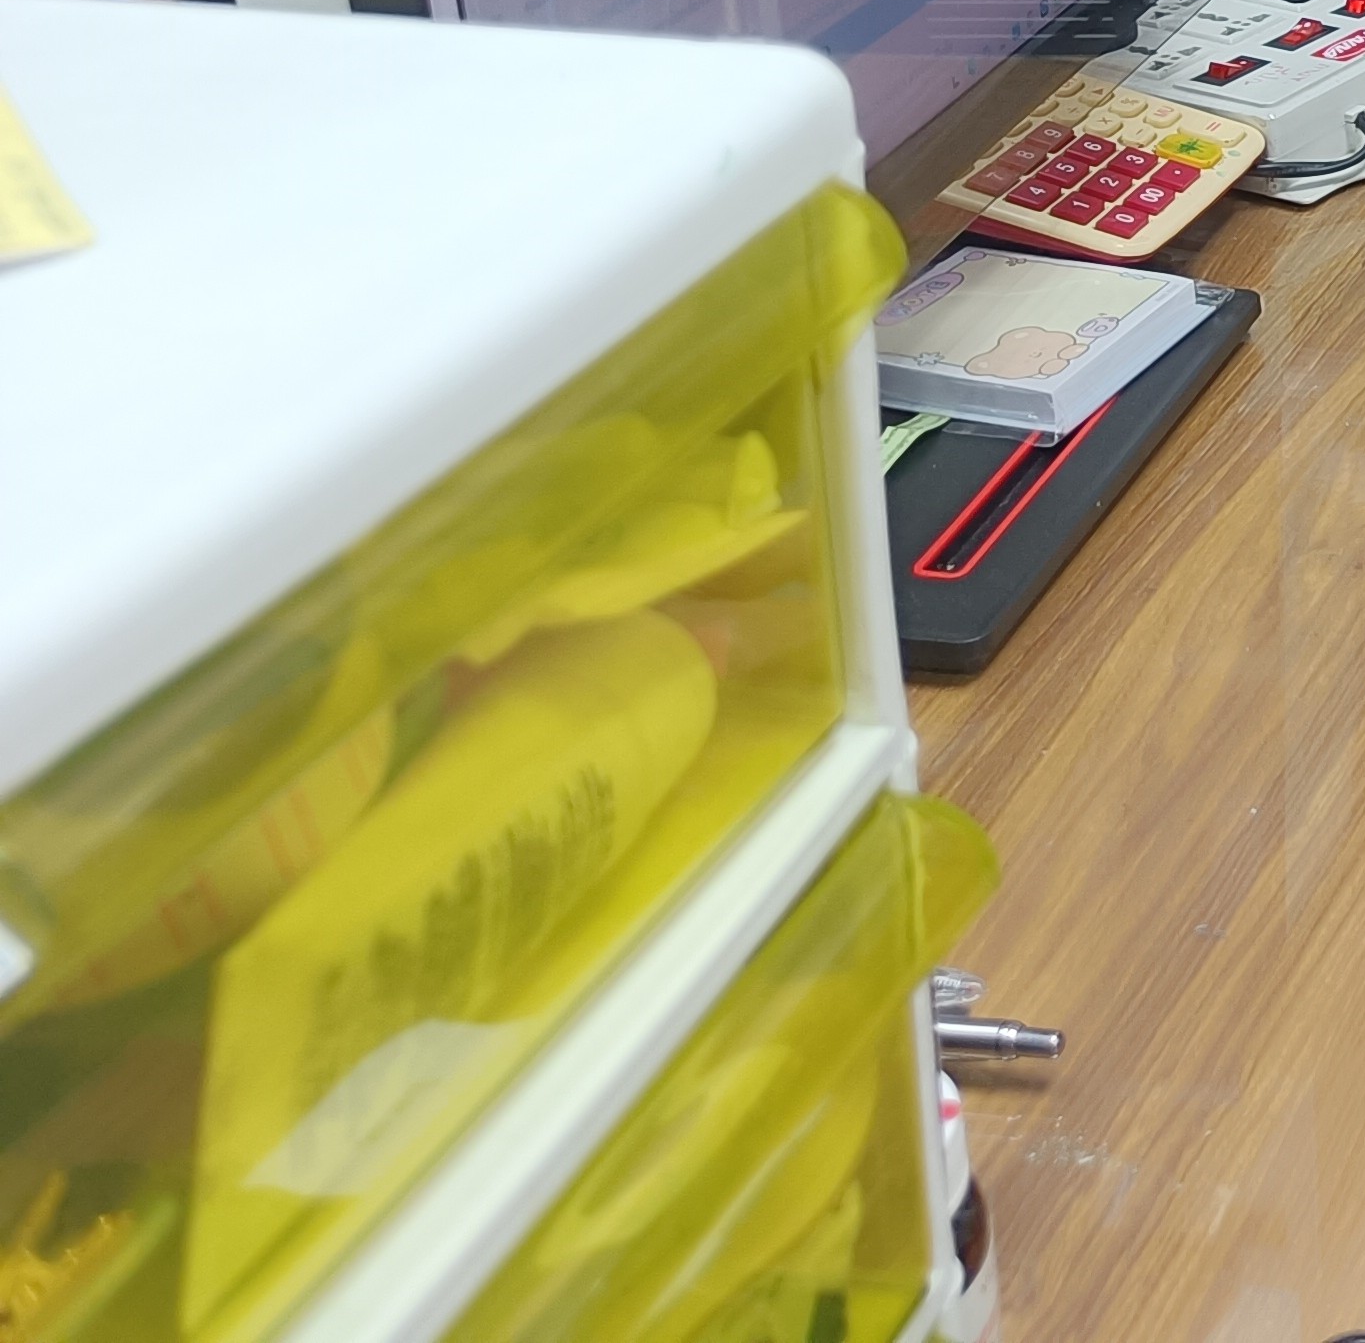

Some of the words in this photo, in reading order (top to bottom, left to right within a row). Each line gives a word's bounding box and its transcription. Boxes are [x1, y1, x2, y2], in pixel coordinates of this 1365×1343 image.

[1016, 149, 1035, 160] 8
[1028, 186, 1047, 197] 4
[1056, 162, 1076, 173] 5
[1083, 141, 1102, 152] 6
[1072, 200, 1090, 210] 1
[1100, 176, 1120, 187] 2
[1125, 154, 1145, 165] 3
[1114, 212, 1135, 224] 0
[1139, 188, 1165, 204] 00
